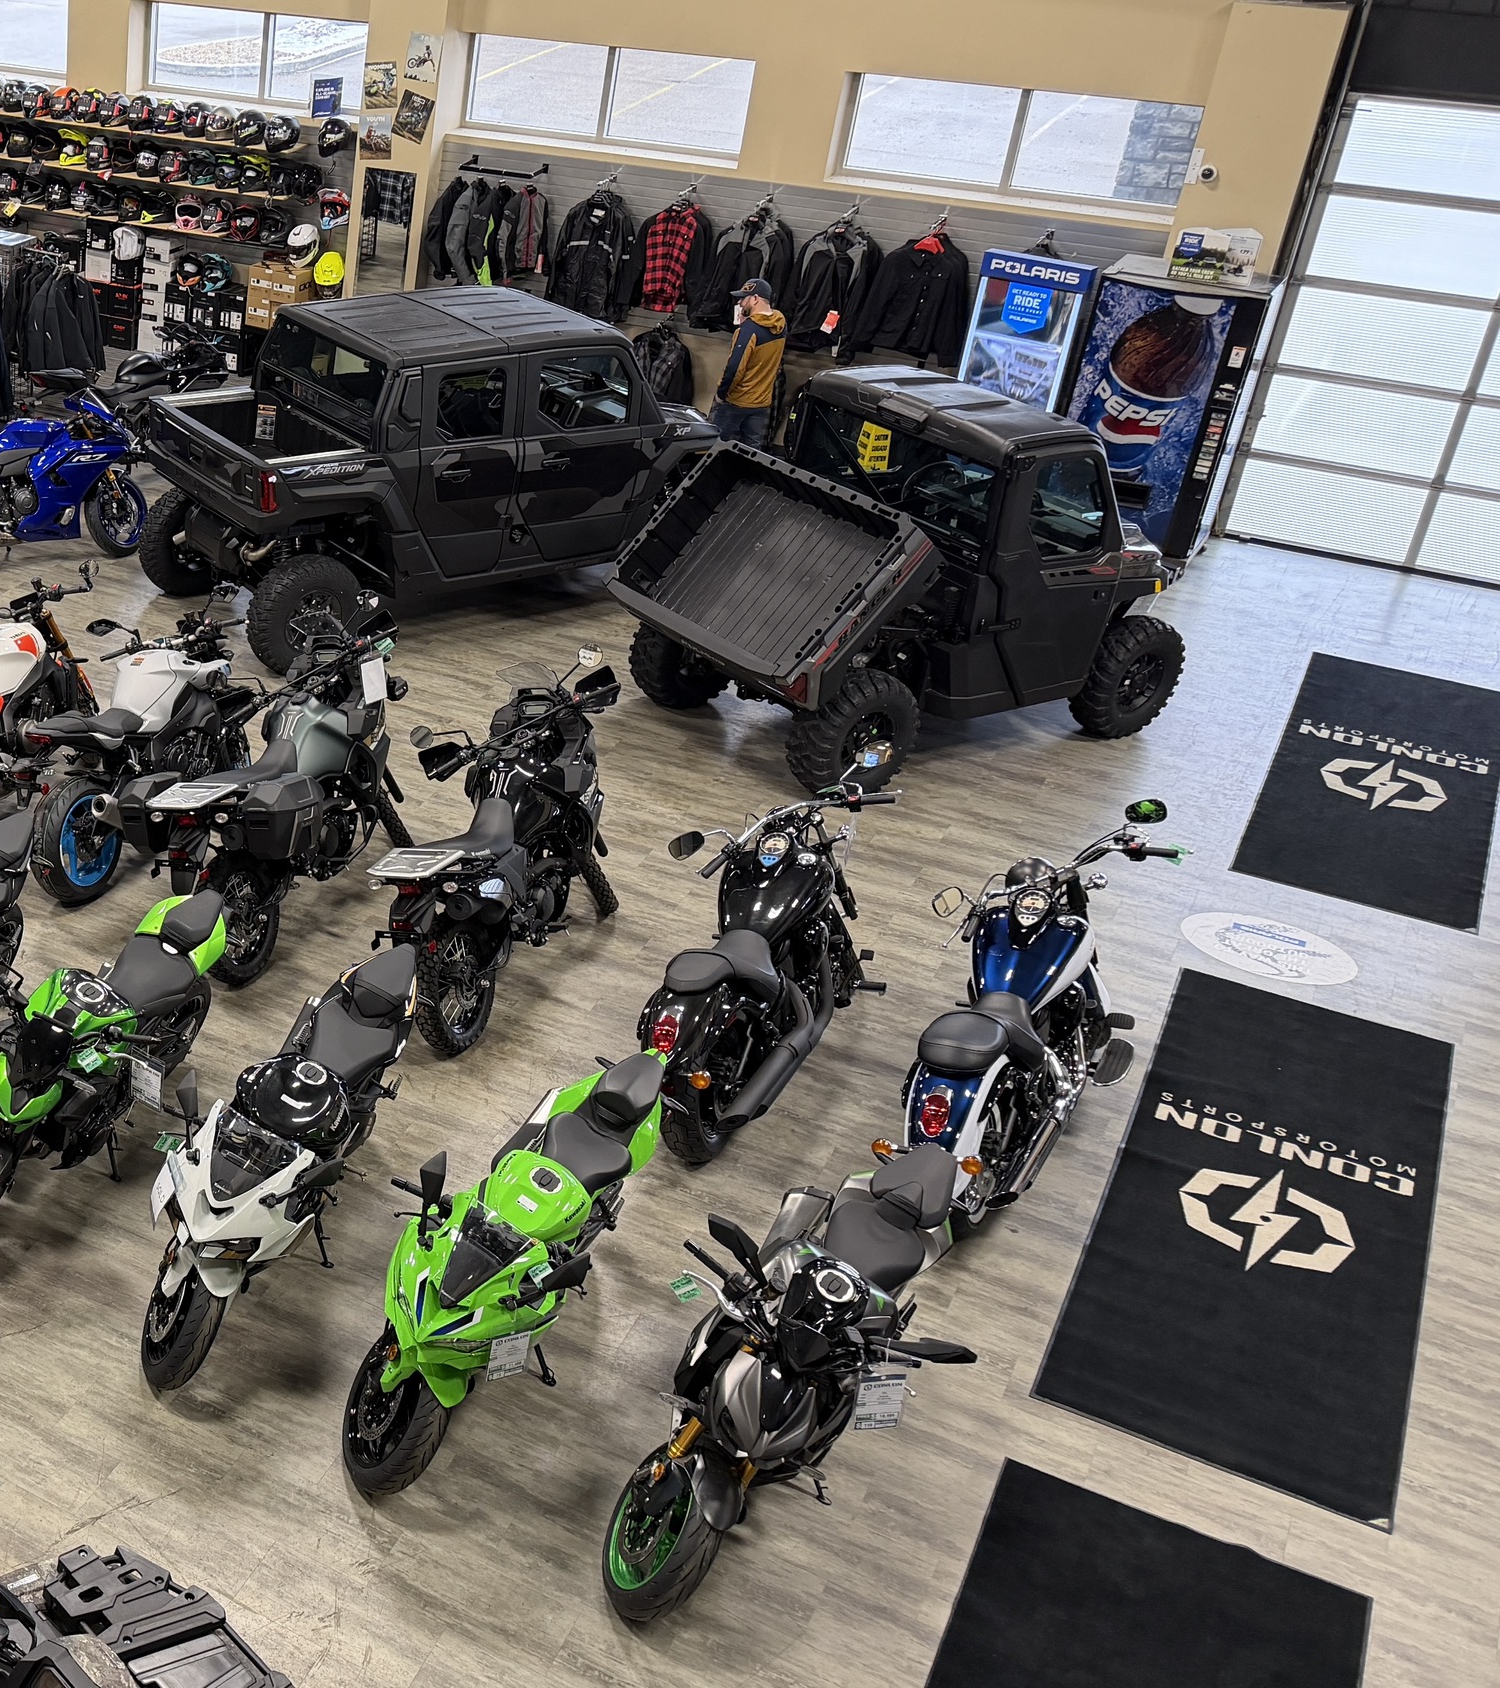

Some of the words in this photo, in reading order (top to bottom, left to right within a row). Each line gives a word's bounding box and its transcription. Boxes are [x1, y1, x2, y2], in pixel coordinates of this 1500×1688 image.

[990, 258, 1080, 285] POLARIS
[1013, 295, 1041, 309] RIDE
[1022, 289, 1039, 298] READY
[1094, 378, 1178, 427] PEPSI
[674, 426, 691, 436] XP
[72, 453, 107, 463] R7
[304, 463, 365, 479] XPEDITION
[1299, 724, 1489, 775] CONLON
[1303, 718, 1490, 765] MOTORSPORTS
[1160, 1091, 1417, 1177] MOTORSPORTS
[1154, 1102, 1415, 1197] CONLON
